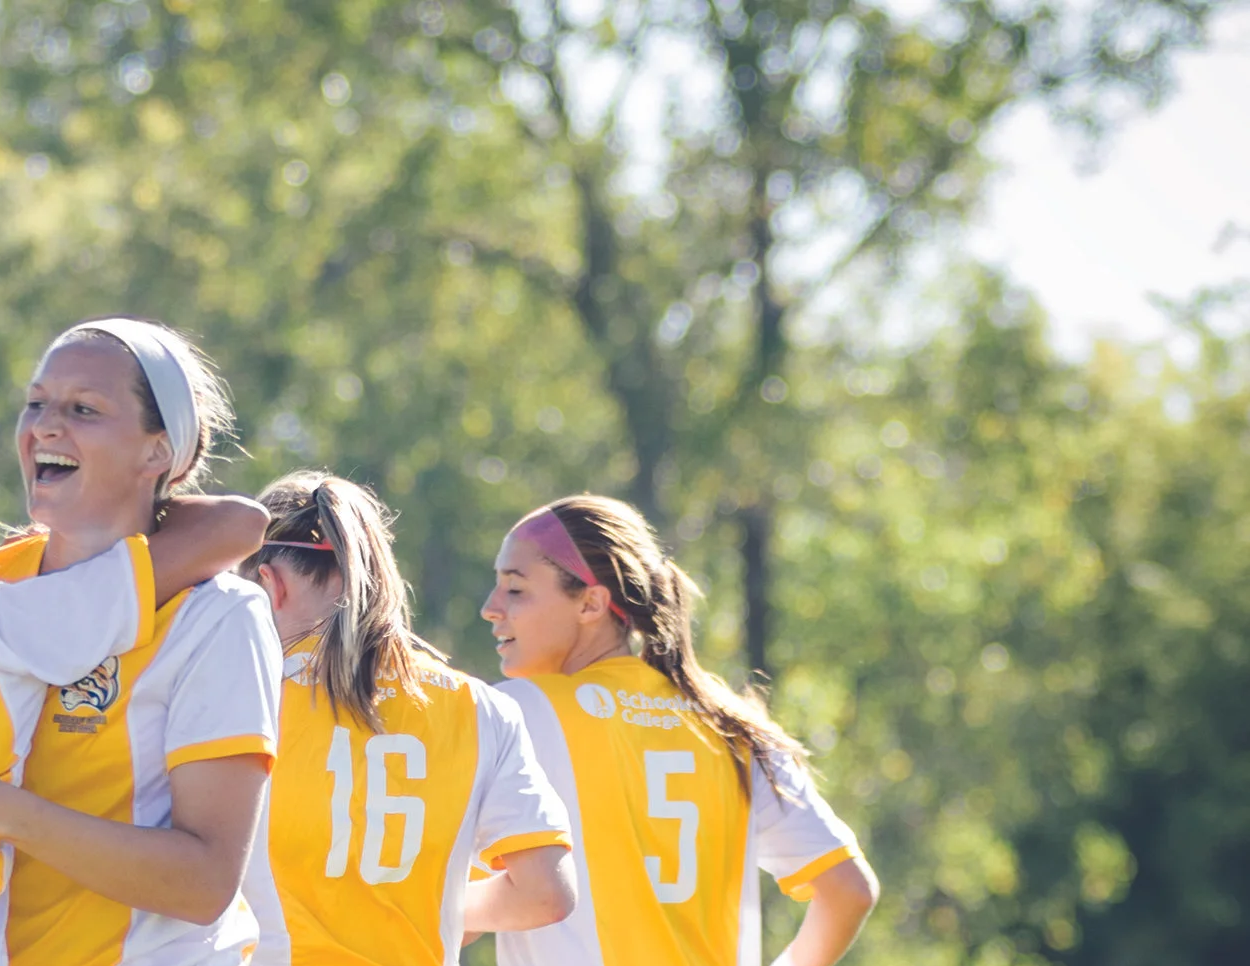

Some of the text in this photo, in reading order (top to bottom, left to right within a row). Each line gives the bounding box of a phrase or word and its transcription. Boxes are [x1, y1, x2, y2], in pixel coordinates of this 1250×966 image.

[621, 708, 682, 730] College
[325, 725, 427, 885] 16
[644, 751, 699, 904] 5
